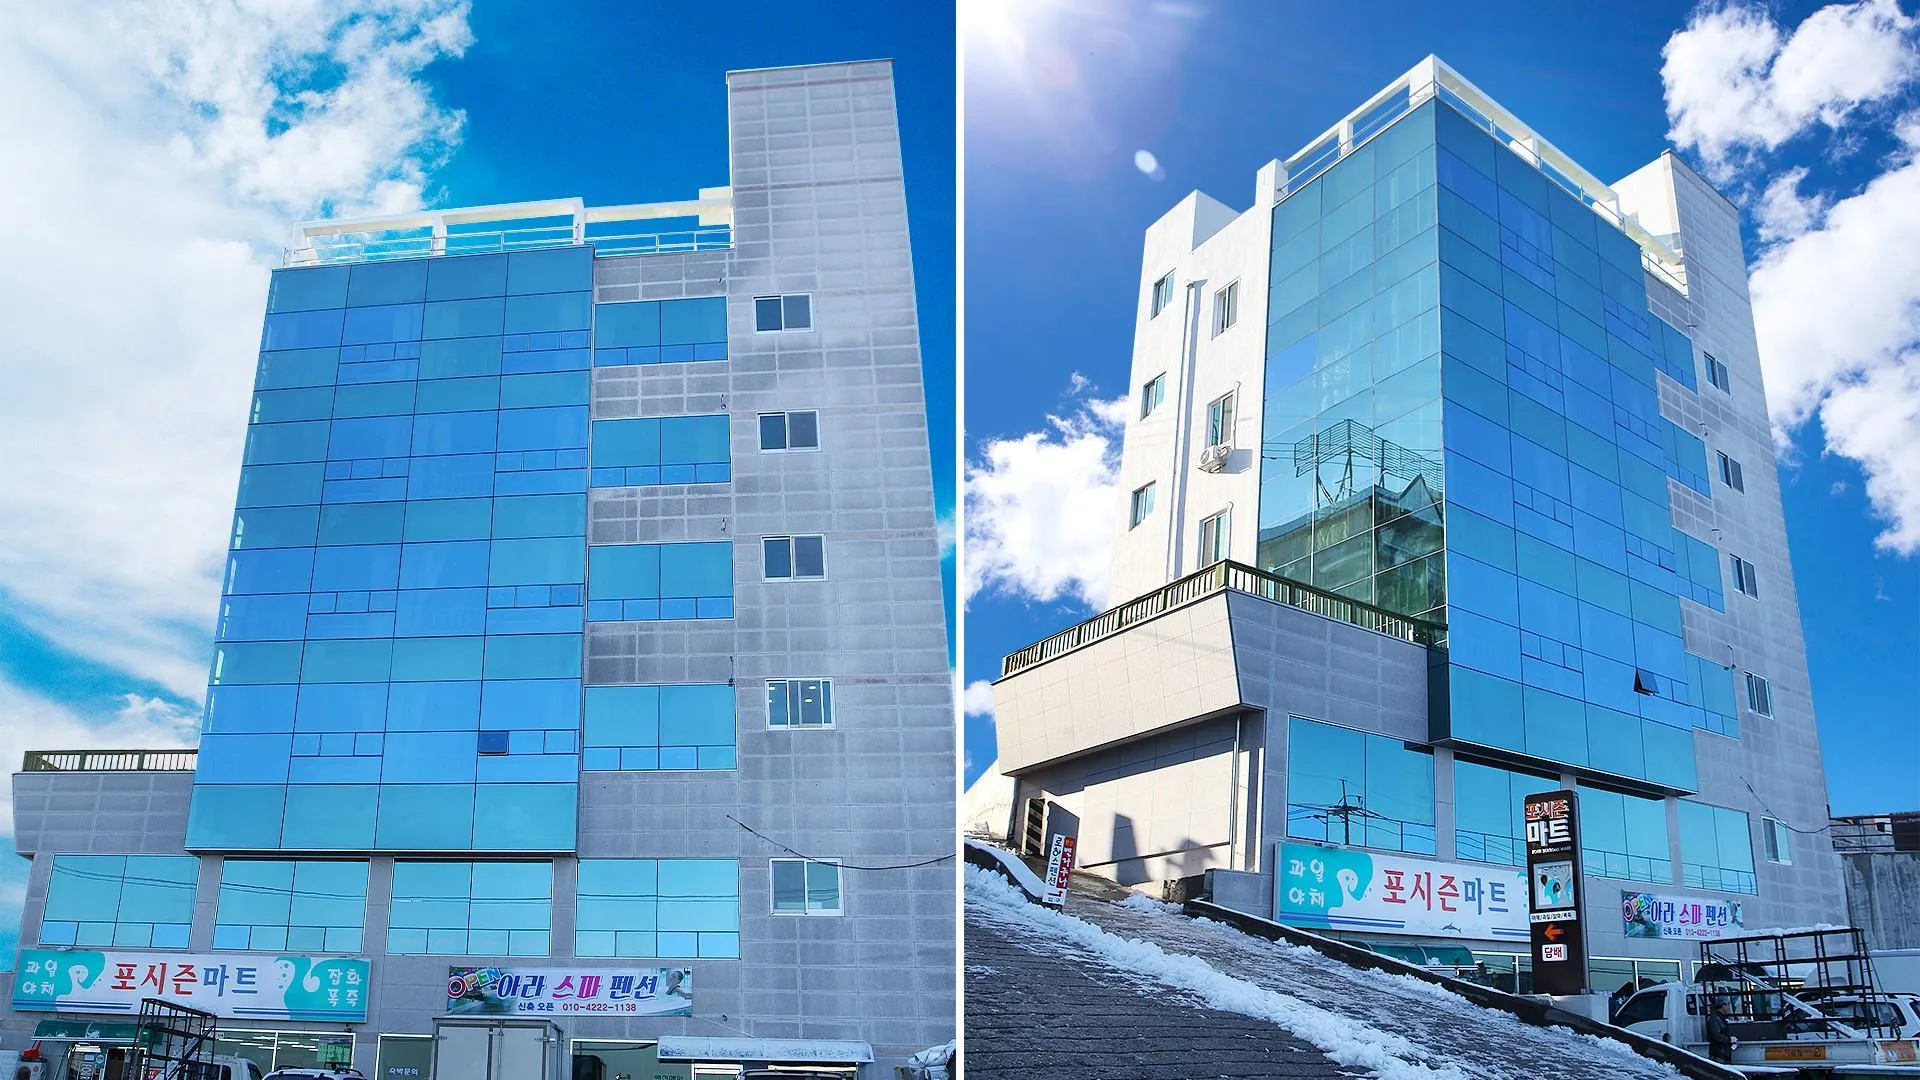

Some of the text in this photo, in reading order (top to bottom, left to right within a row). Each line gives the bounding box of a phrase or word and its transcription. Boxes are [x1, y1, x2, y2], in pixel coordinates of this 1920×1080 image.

[1526, 800, 1570, 820] 포시즌
[1527, 819, 1571, 847] 마트
[1289, 859, 1325, 884] 과일
[1288, 888, 1324, 908] 야채
[1382, 869, 1509, 915] 포시즌마트
[1651, 900, 1728, 927] 아라 스파 펜션
[1544, 946, 1563, 959] 담배
[24, 959, 58, 978] 과일
[327, 968, 362, 987] 잡화
[22, 981, 55, 996] 야채
[110, 962, 259, 997] 포시즌마트
[448, 967, 501, 999] OPEN
[497, 974, 659, 1001] 아라 스파 펜션
[327, 988, 359, 1008] 폭죽
[518, 1002, 637, 1013] 신축 오픈 010-4222-1138
